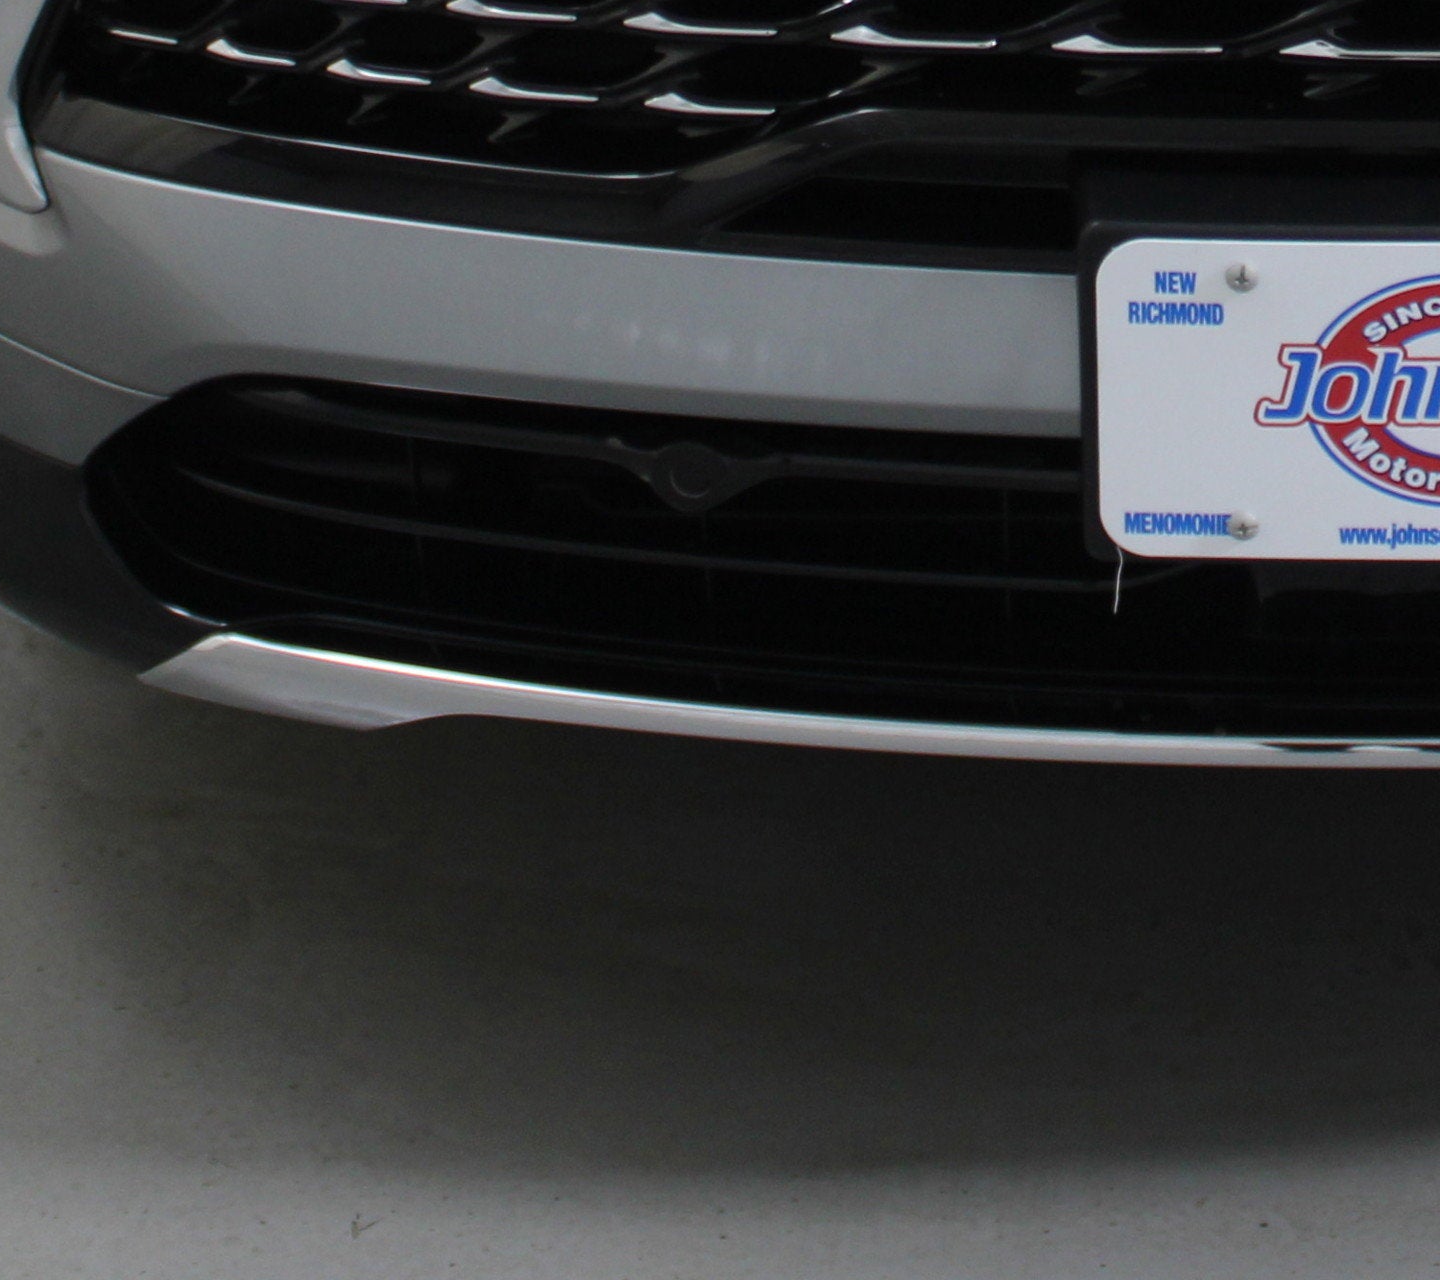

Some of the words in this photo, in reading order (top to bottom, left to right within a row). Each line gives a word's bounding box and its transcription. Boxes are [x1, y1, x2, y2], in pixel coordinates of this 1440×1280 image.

[1154, 270, 1197, 295] NEW
[1128, 302, 1224, 325] RICHMOND
[1124, 512, 1231, 536] MENOMONIE
